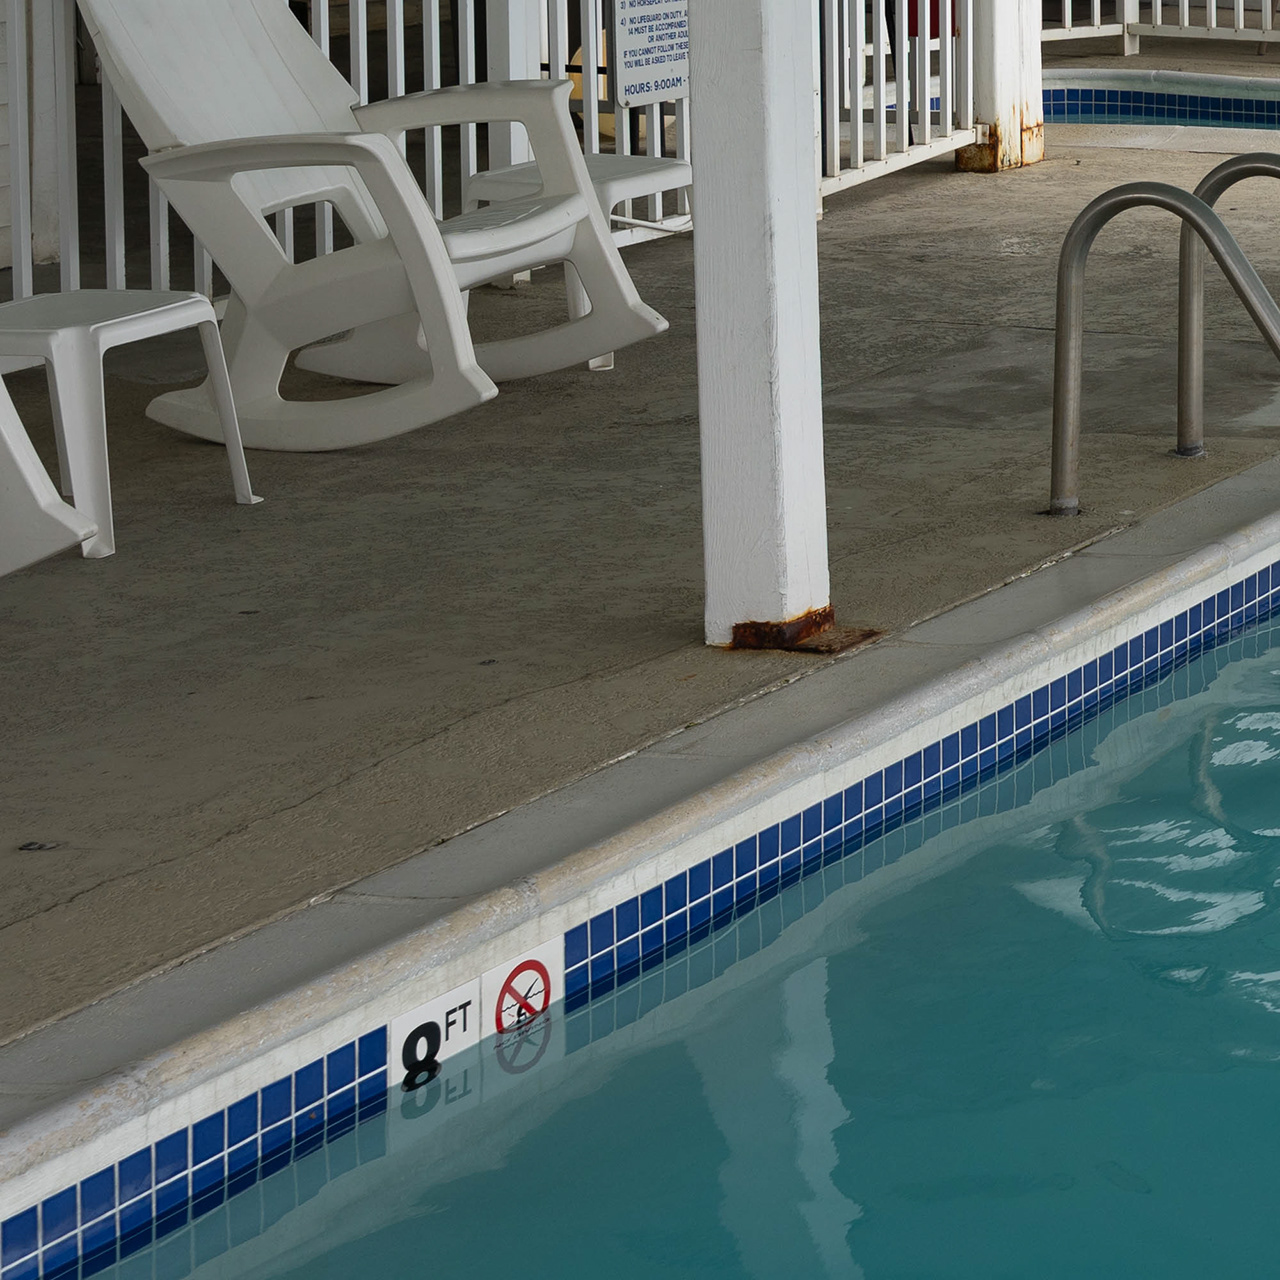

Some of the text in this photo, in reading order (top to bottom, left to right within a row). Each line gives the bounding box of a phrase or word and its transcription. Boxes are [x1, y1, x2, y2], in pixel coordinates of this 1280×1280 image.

[629, 0, 636, 8] NO
[629, 16, 636, 25] NO
[637, 13, 661, 24] LIFEGUARD
[634, 25, 647, 34] MUST
[655, 31, 676, 41] ANOTHER
[629, 49, 638, 58] YOU
[638, 46, 656, 56] CANNOT
[657, 44, 674, 53] FOLLOW
[624, 60, 633, 69] YOU
[652, 55, 666, 64] ASKED
[624, 76, 682, 96] HOURS: 9:00AM
[402, 1000, 472, 1092] 8 FT
